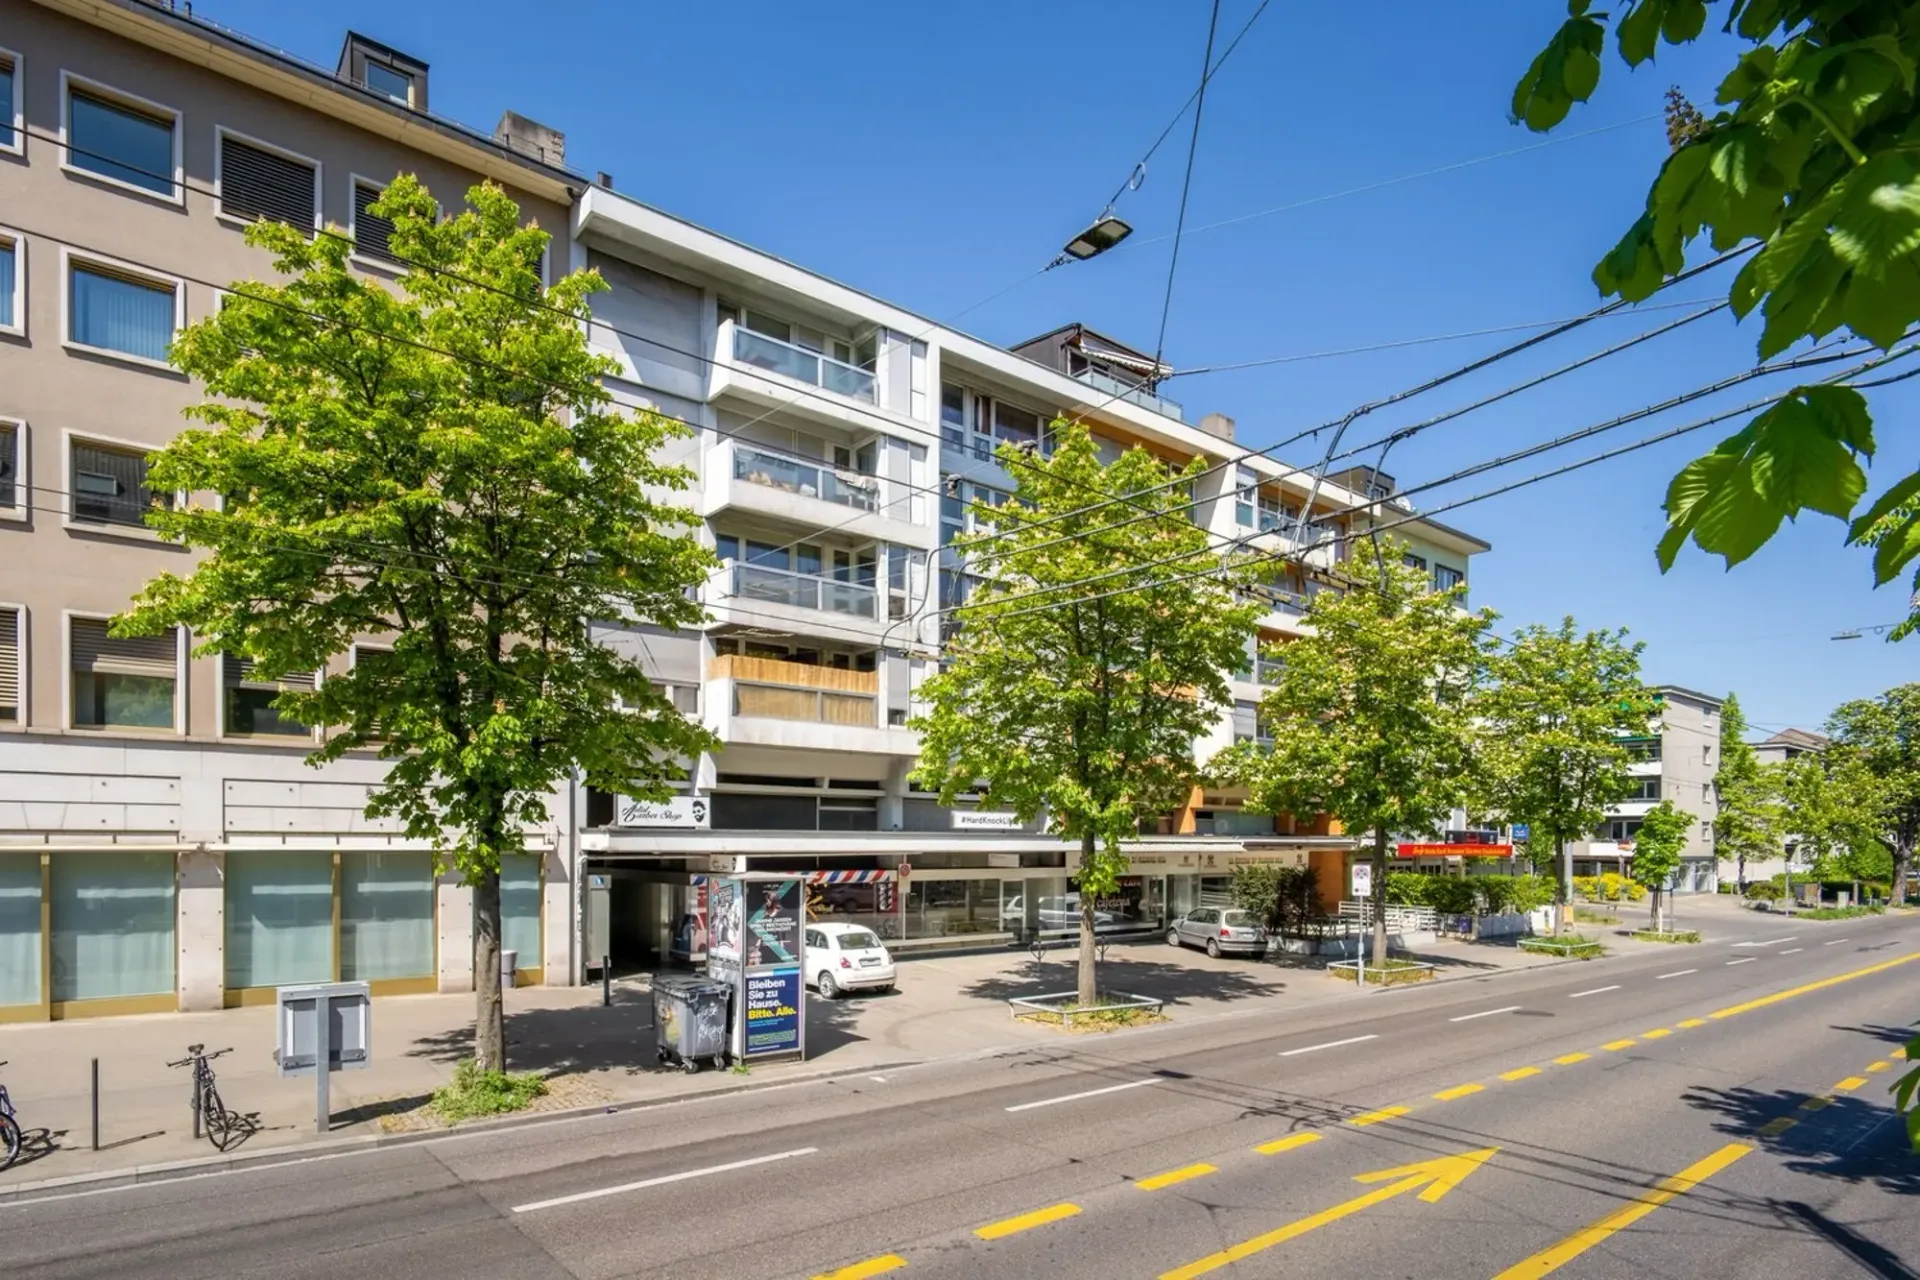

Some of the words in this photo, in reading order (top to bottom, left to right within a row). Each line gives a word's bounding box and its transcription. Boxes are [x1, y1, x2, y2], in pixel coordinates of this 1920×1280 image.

[659, 810, 682, 822] Shop
[961, 816, 1013, 826] #HardKnockLi
[748, 979, 785, 990] Bleiben
[748, 990, 764, 1000] Sie
[766, 990, 778, 998] zu
[748, 1000, 782, 1009] Hause.
[748, 1009, 775, 1019] Bitte.
[776, 1006, 797, 1016] Alle.
